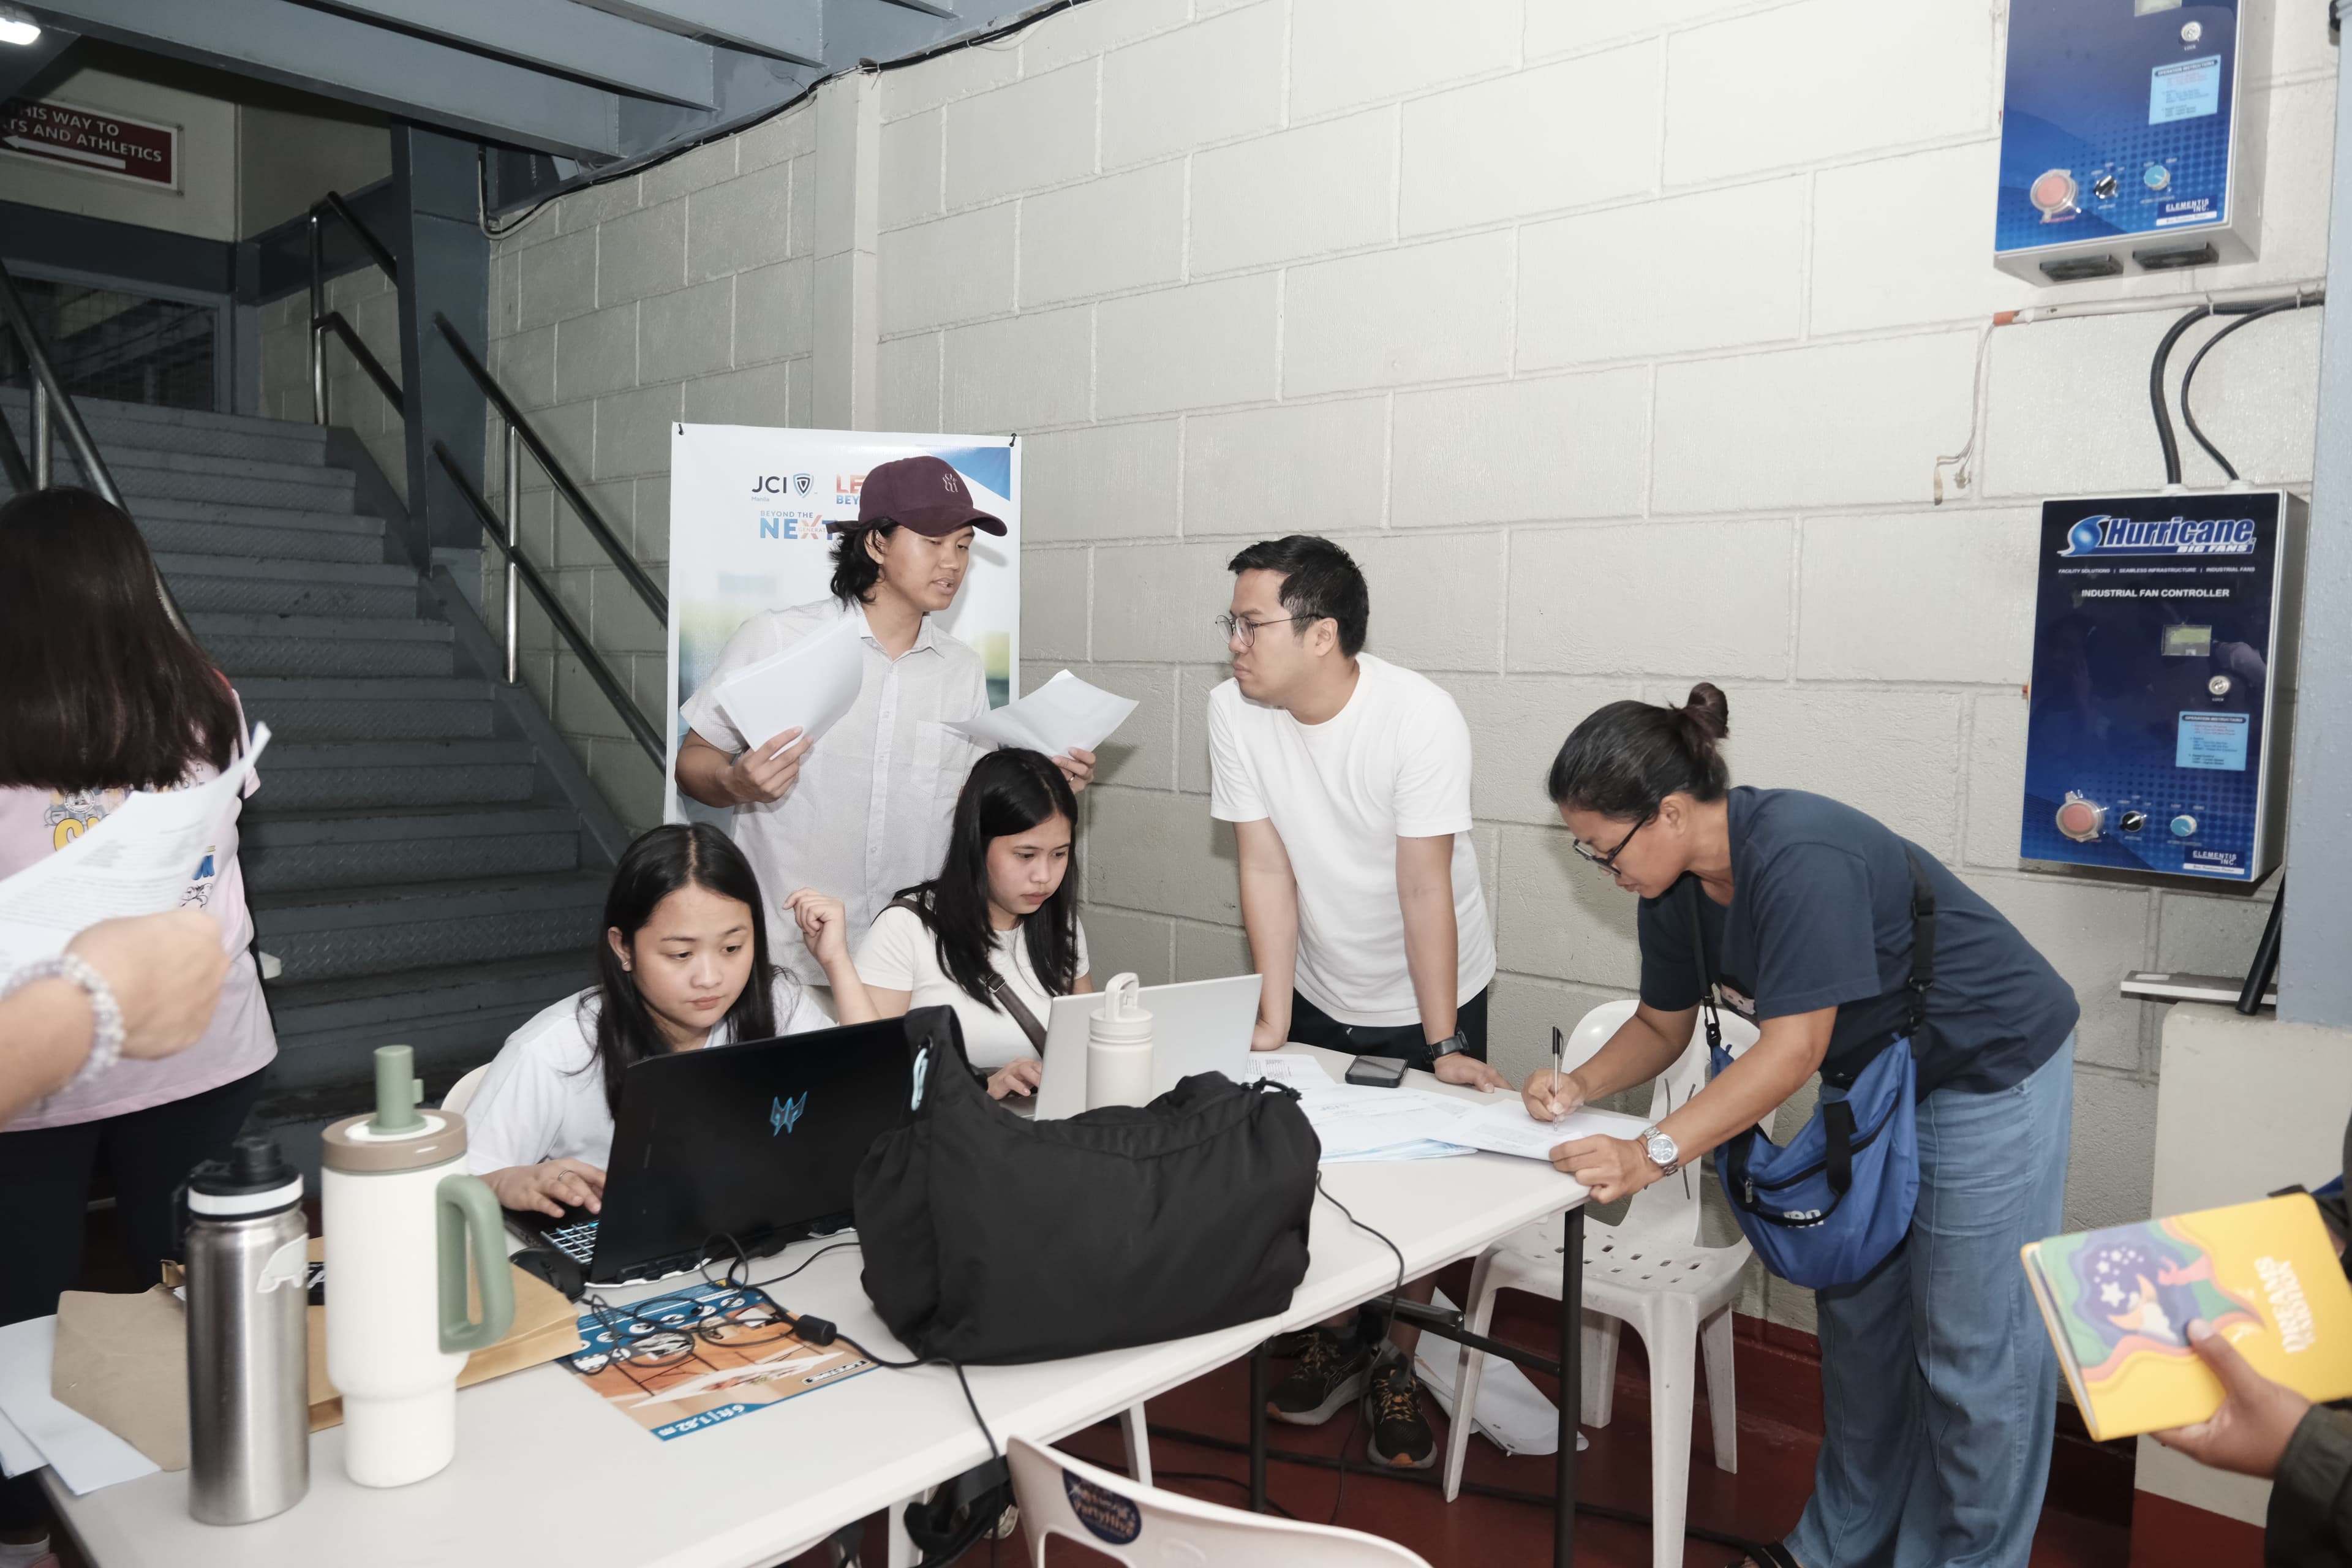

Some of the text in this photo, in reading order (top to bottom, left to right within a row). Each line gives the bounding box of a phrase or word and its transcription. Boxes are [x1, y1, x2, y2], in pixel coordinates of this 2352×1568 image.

[53, 110, 92, 130] WAY
[97, 121, 119, 137] TO
[33, 123, 71, 141] AND
[77, 135, 162, 162] ATHLETICS
[2166, 198, 2209, 212] ELEMENTIS
[752, 476, 787, 494] JCI
[836, 474, 867, 494] LE
[836, 494, 860, 505] BEY
[2103, 516, 2255, 547] Hurricane
[2177, 544, 2248, 553] BIG FANS
[2161, 589, 2230, 597] CONTROLLER
[2193, 850, 2237, 860] ELEMENTIS
